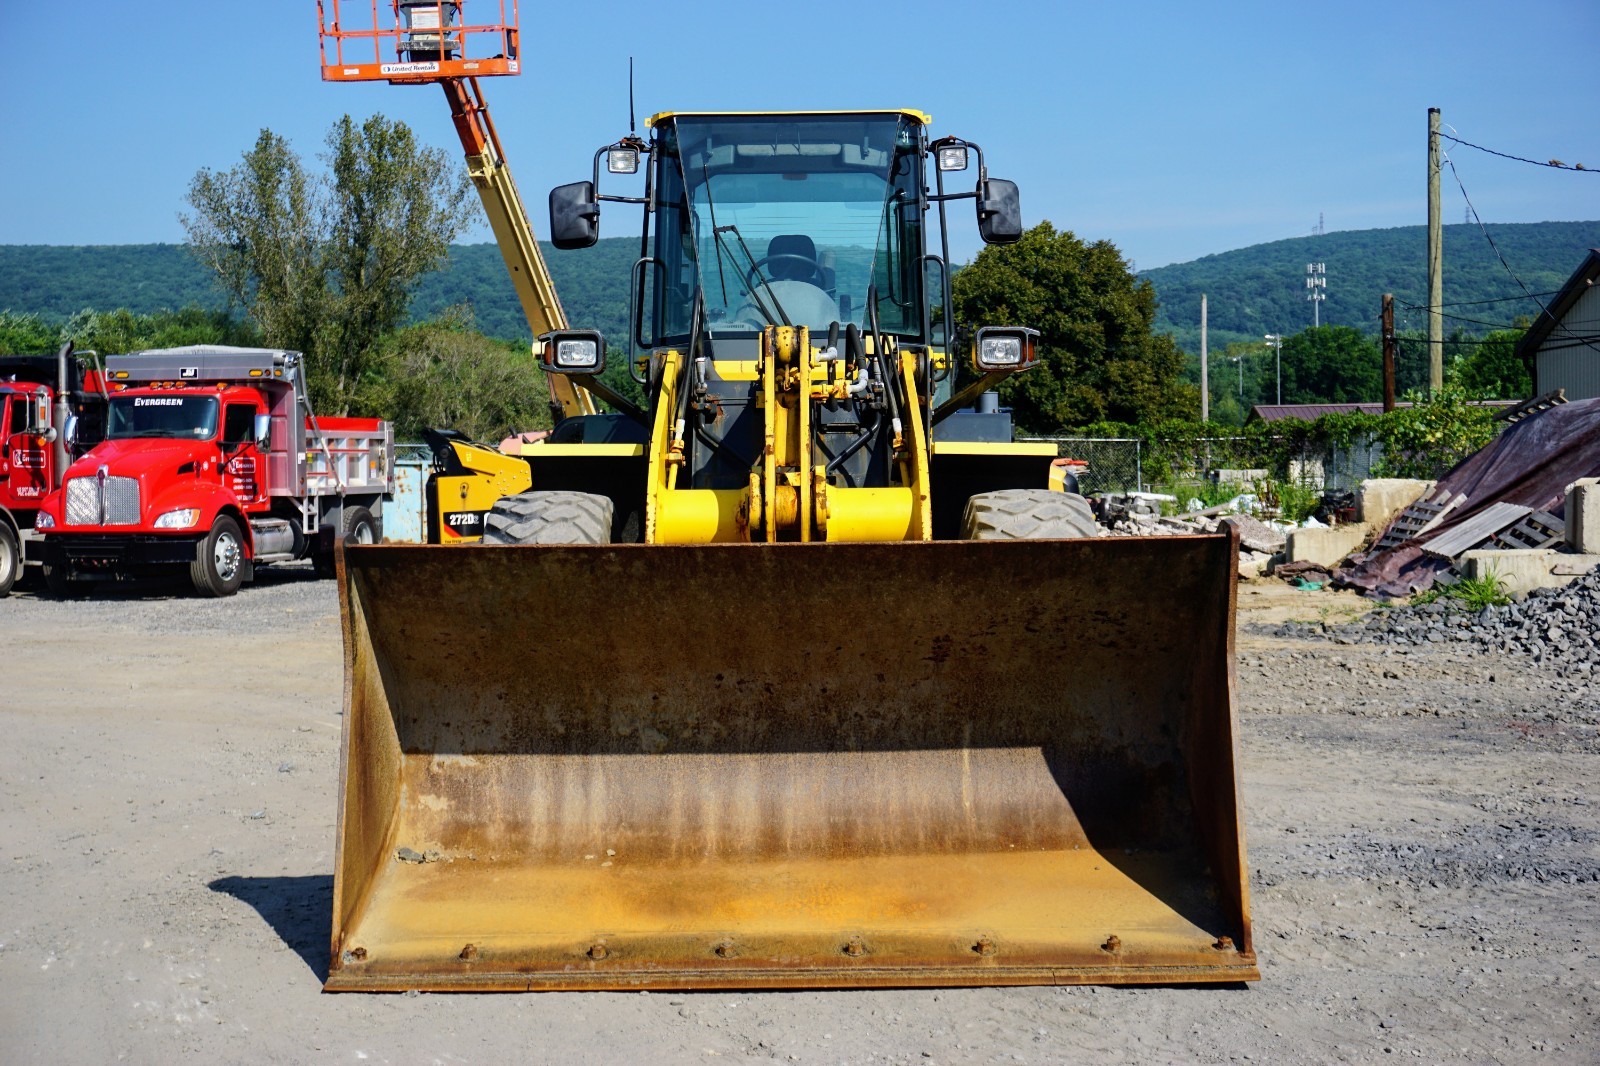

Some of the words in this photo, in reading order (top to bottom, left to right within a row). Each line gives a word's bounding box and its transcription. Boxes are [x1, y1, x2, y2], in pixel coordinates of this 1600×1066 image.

[413, 63, 436, 71] Rentals
[902, 130, 909, 143] 31
[134, 397, 184, 407] EVERGREEN
